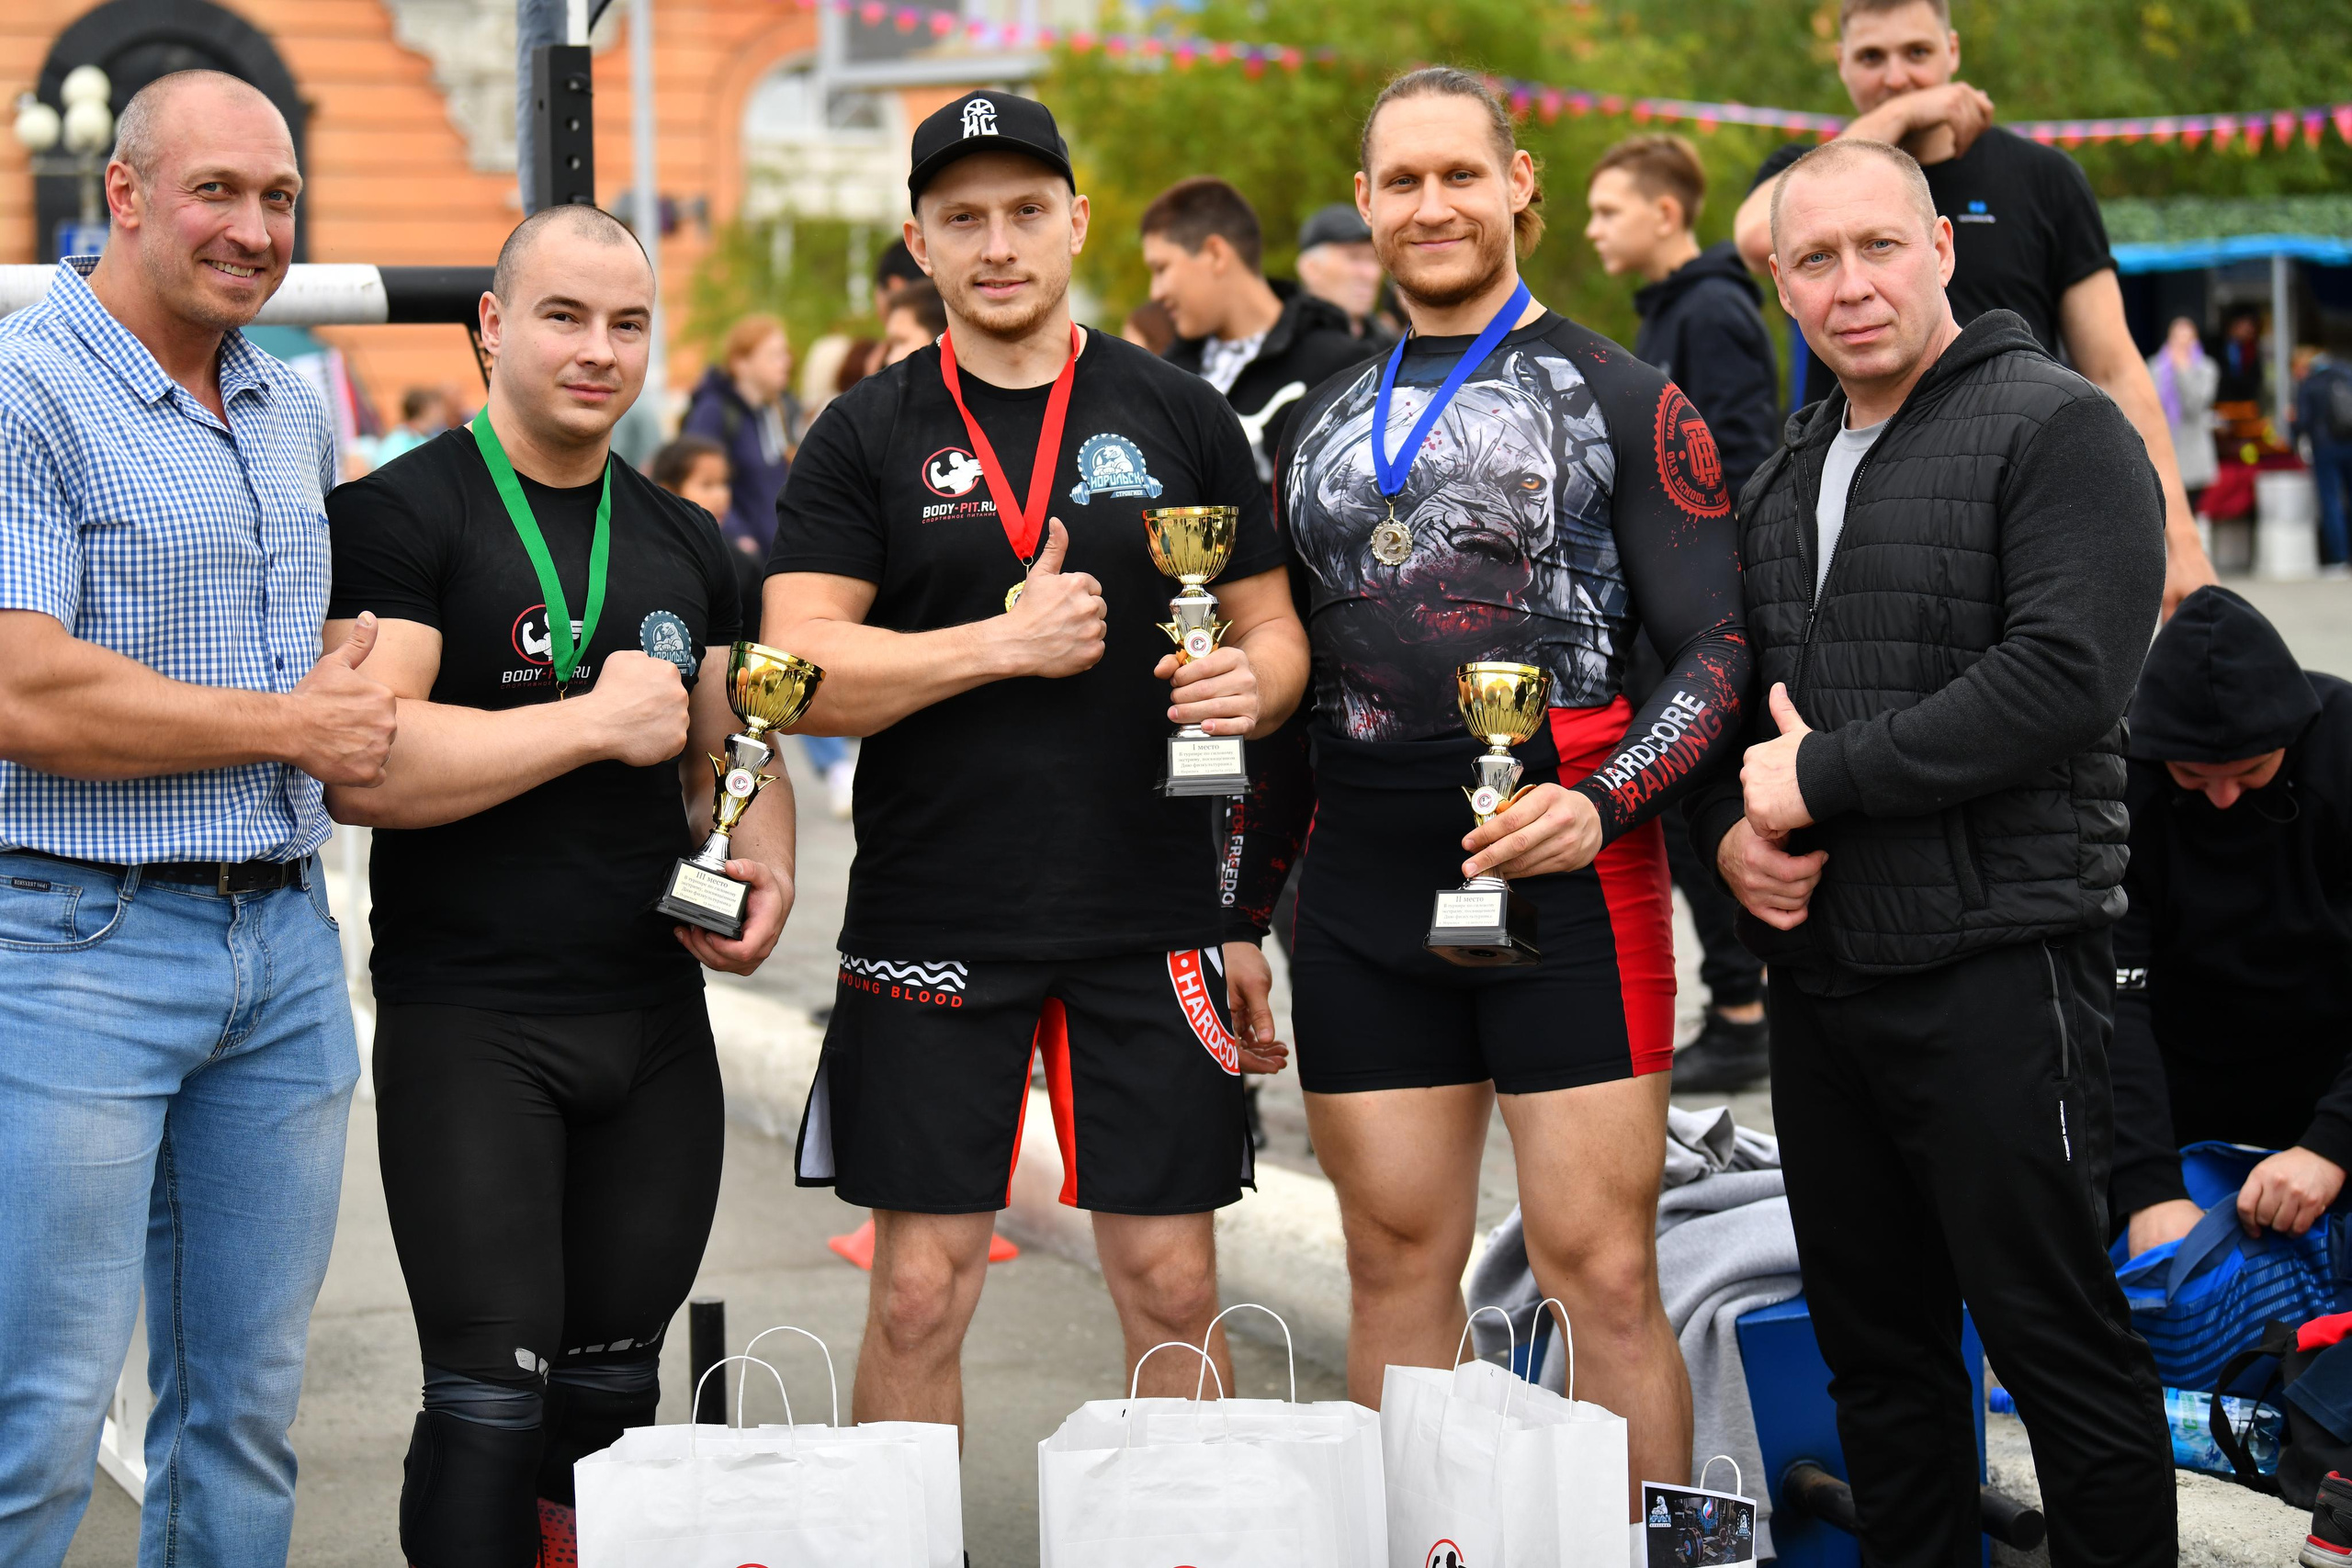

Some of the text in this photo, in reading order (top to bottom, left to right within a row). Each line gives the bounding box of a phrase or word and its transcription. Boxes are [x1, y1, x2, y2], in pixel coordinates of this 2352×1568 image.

[1667, 450, 1680, 476] OLD
[1675, 477, 1707, 505] SCHOOL
[922, 501, 997, 518] BODY-PIT.RU
[922, 514, 964, 525] СПОРТИВНОЕ
[1384, 530, 1402, 554] 2
[707, 876, 729, 888] место
[1221, 835, 1244, 908] FREEDO
[841, 971, 963, 1009] YOUNG BLOOD
